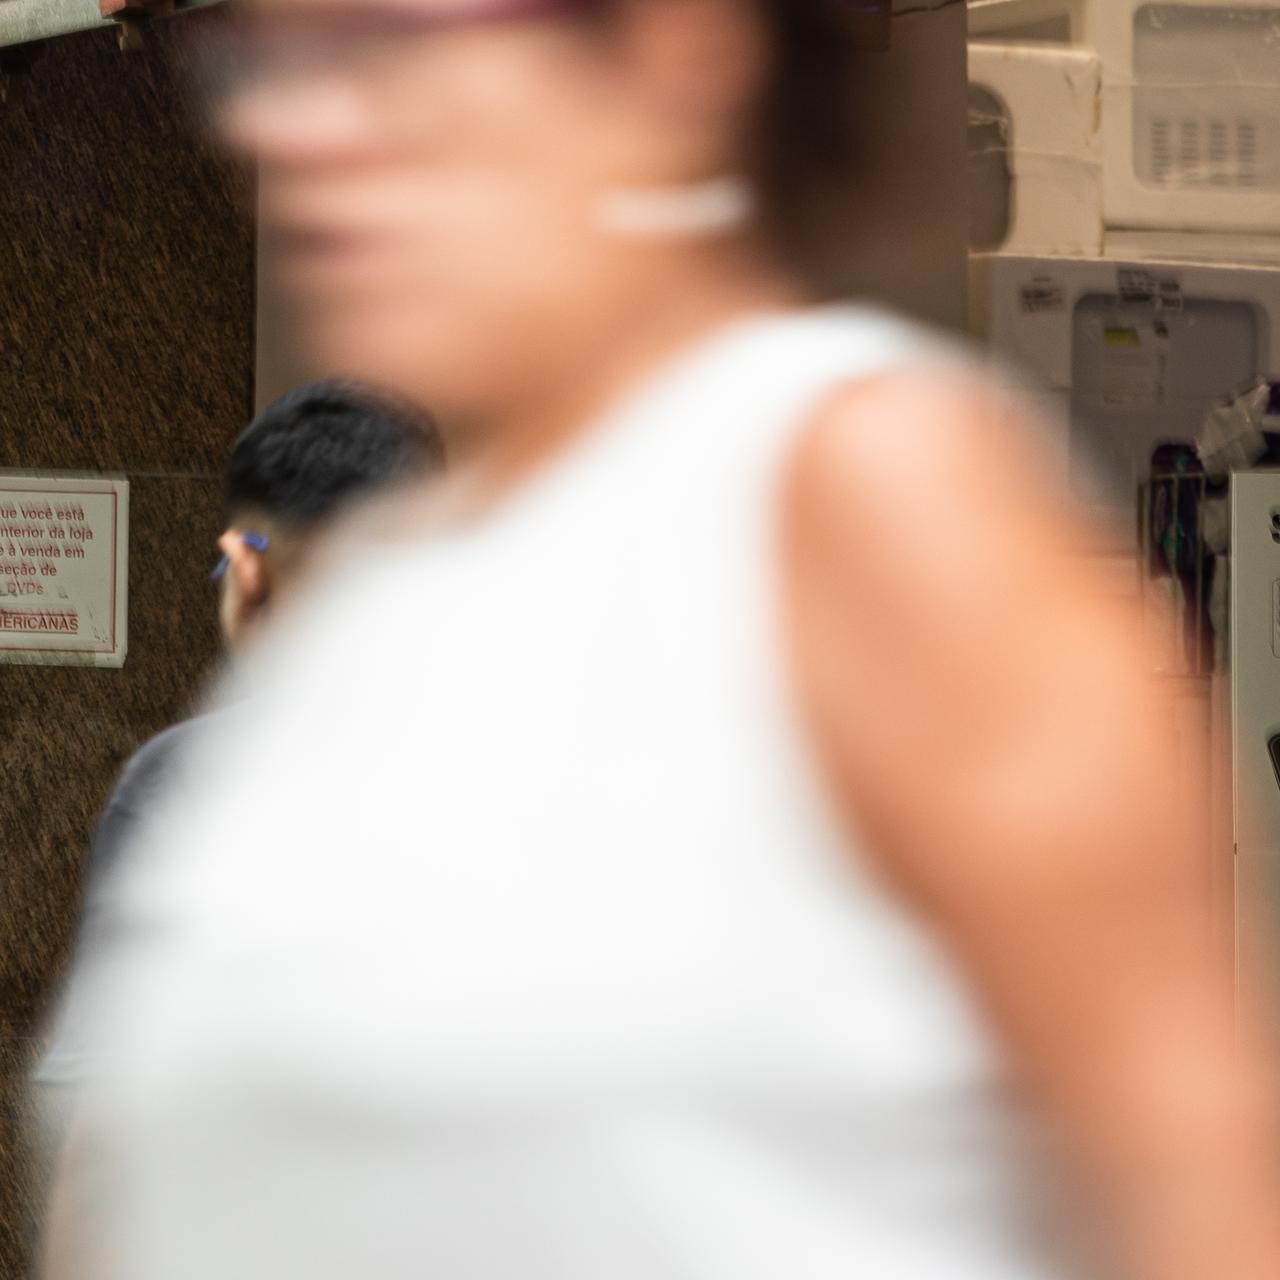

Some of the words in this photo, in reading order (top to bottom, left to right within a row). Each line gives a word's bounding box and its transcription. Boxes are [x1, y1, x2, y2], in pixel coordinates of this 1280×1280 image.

[21, 504, 53, 519] você
[49, 526, 65, 539] da
[70, 526, 93, 542] loja
[20, 543, 61, 558] venda
[64, 546, 84, 558] em
[40, 562, 57, 576] de
